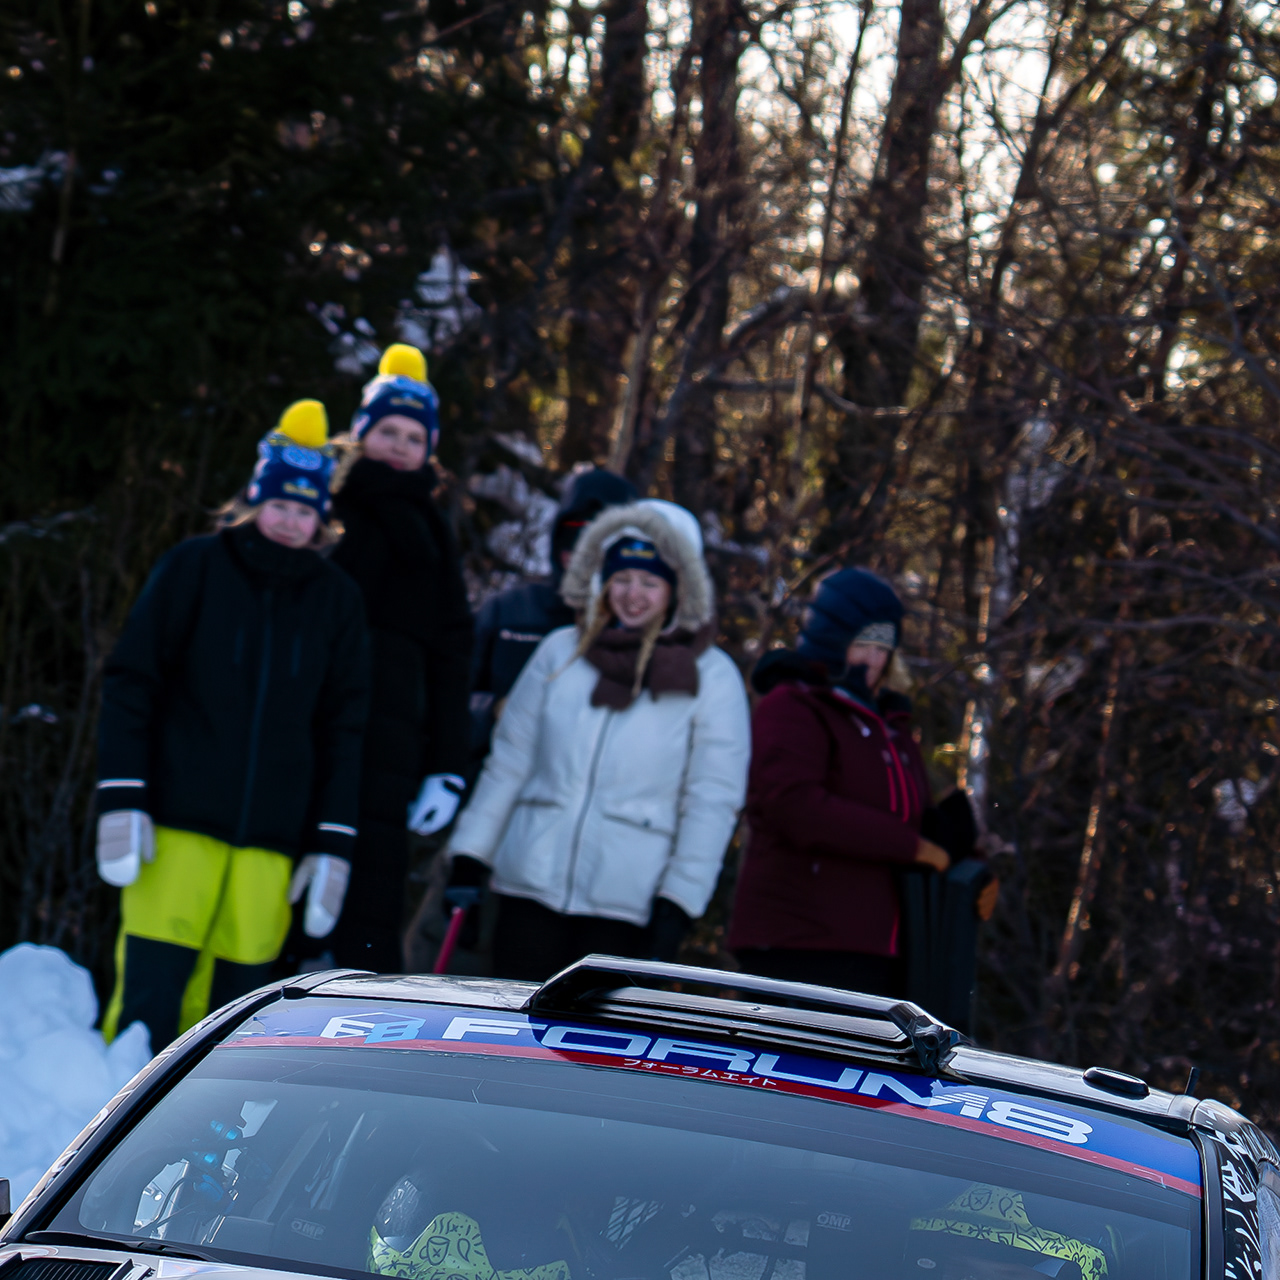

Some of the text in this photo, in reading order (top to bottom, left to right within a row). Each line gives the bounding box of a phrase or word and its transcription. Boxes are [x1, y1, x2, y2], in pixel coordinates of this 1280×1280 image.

[441, 1016, 1094, 1145] FORUM8
[623, 1058, 777, 1087] フォーラムエイト
[816, 1213, 851, 1229] OMP
